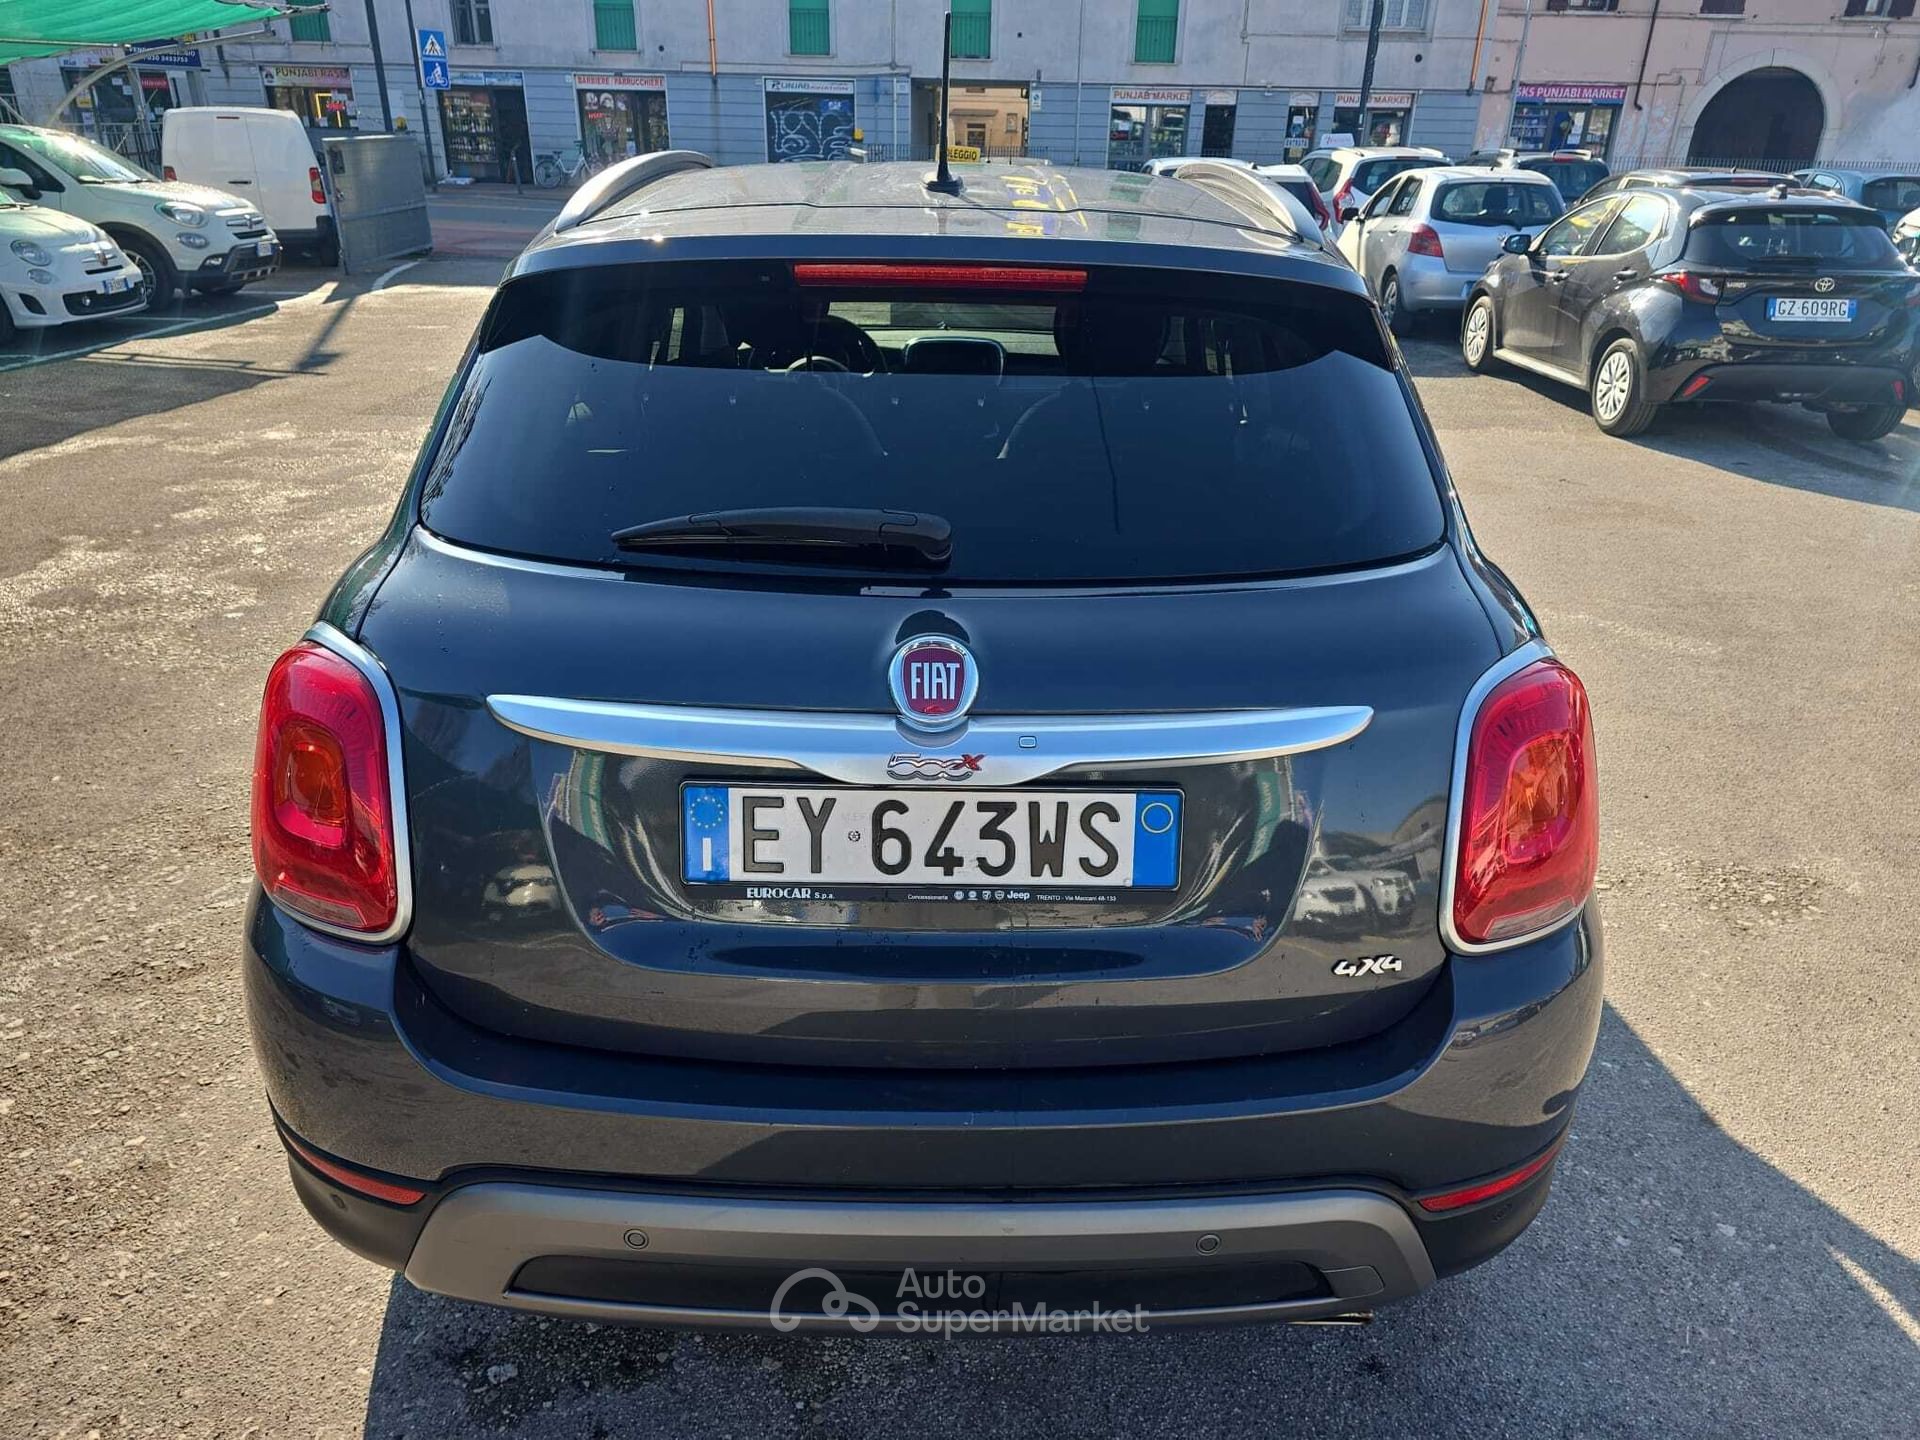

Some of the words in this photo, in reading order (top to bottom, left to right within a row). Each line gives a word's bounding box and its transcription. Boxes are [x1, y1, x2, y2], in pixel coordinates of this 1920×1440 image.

[1113, 90, 1150, 100] PUNJAB
[1151, 91, 1190, 101] MARKET
[1536, 87, 1580, 98] PUNJABI
[1582, 89, 1625, 99] MARKET
[1778, 300, 1797, 316] GZ
[1800, 300, 1848, 317] 609RG
[910, 662, 961, 700] FIAT
[742, 796, 837, 874] EY
[871, 799, 1121, 878] 643WS
[746, 887, 811, 899] EUROCAR
[1006, 890, 1030, 900] Jeep
